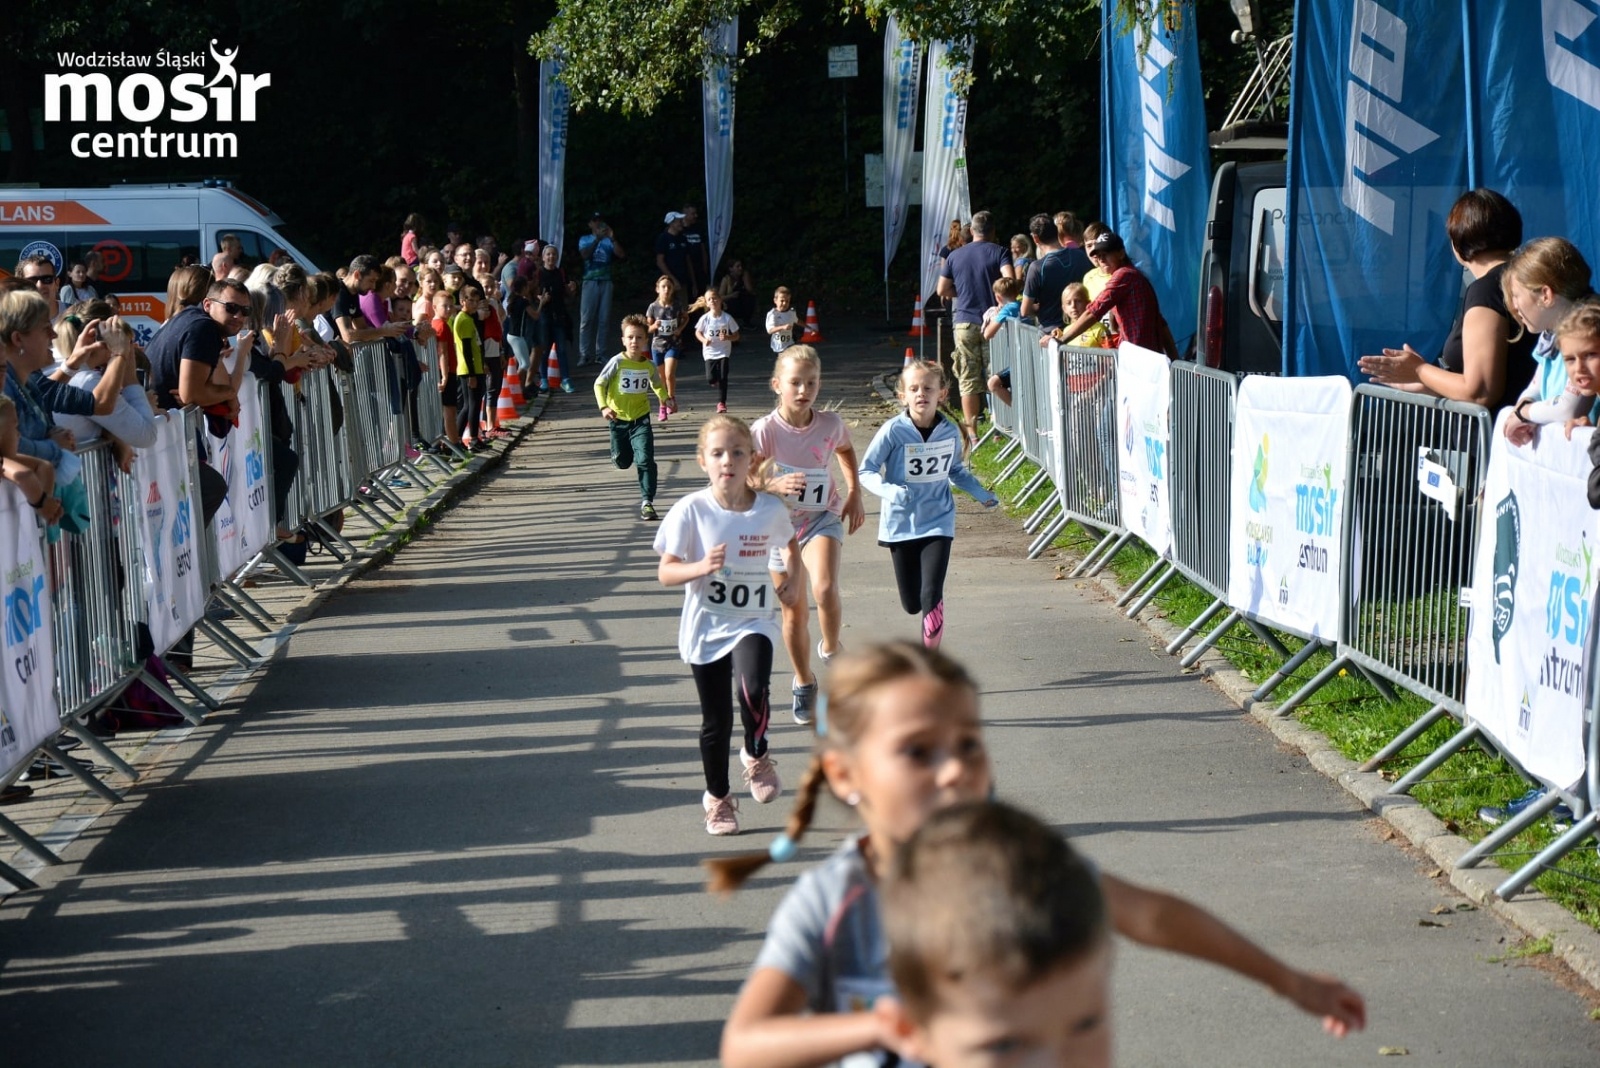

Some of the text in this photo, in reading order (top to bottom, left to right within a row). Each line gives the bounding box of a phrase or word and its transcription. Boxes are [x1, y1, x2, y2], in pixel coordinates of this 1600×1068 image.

[134, 302, 152, 312] 112
[709, 328, 727, 337] 329
[621, 377, 649, 390] 318
[908, 453, 952, 476] 327
[784, 484, 824, 504] 11
[707, 580, 767, 608] 301
